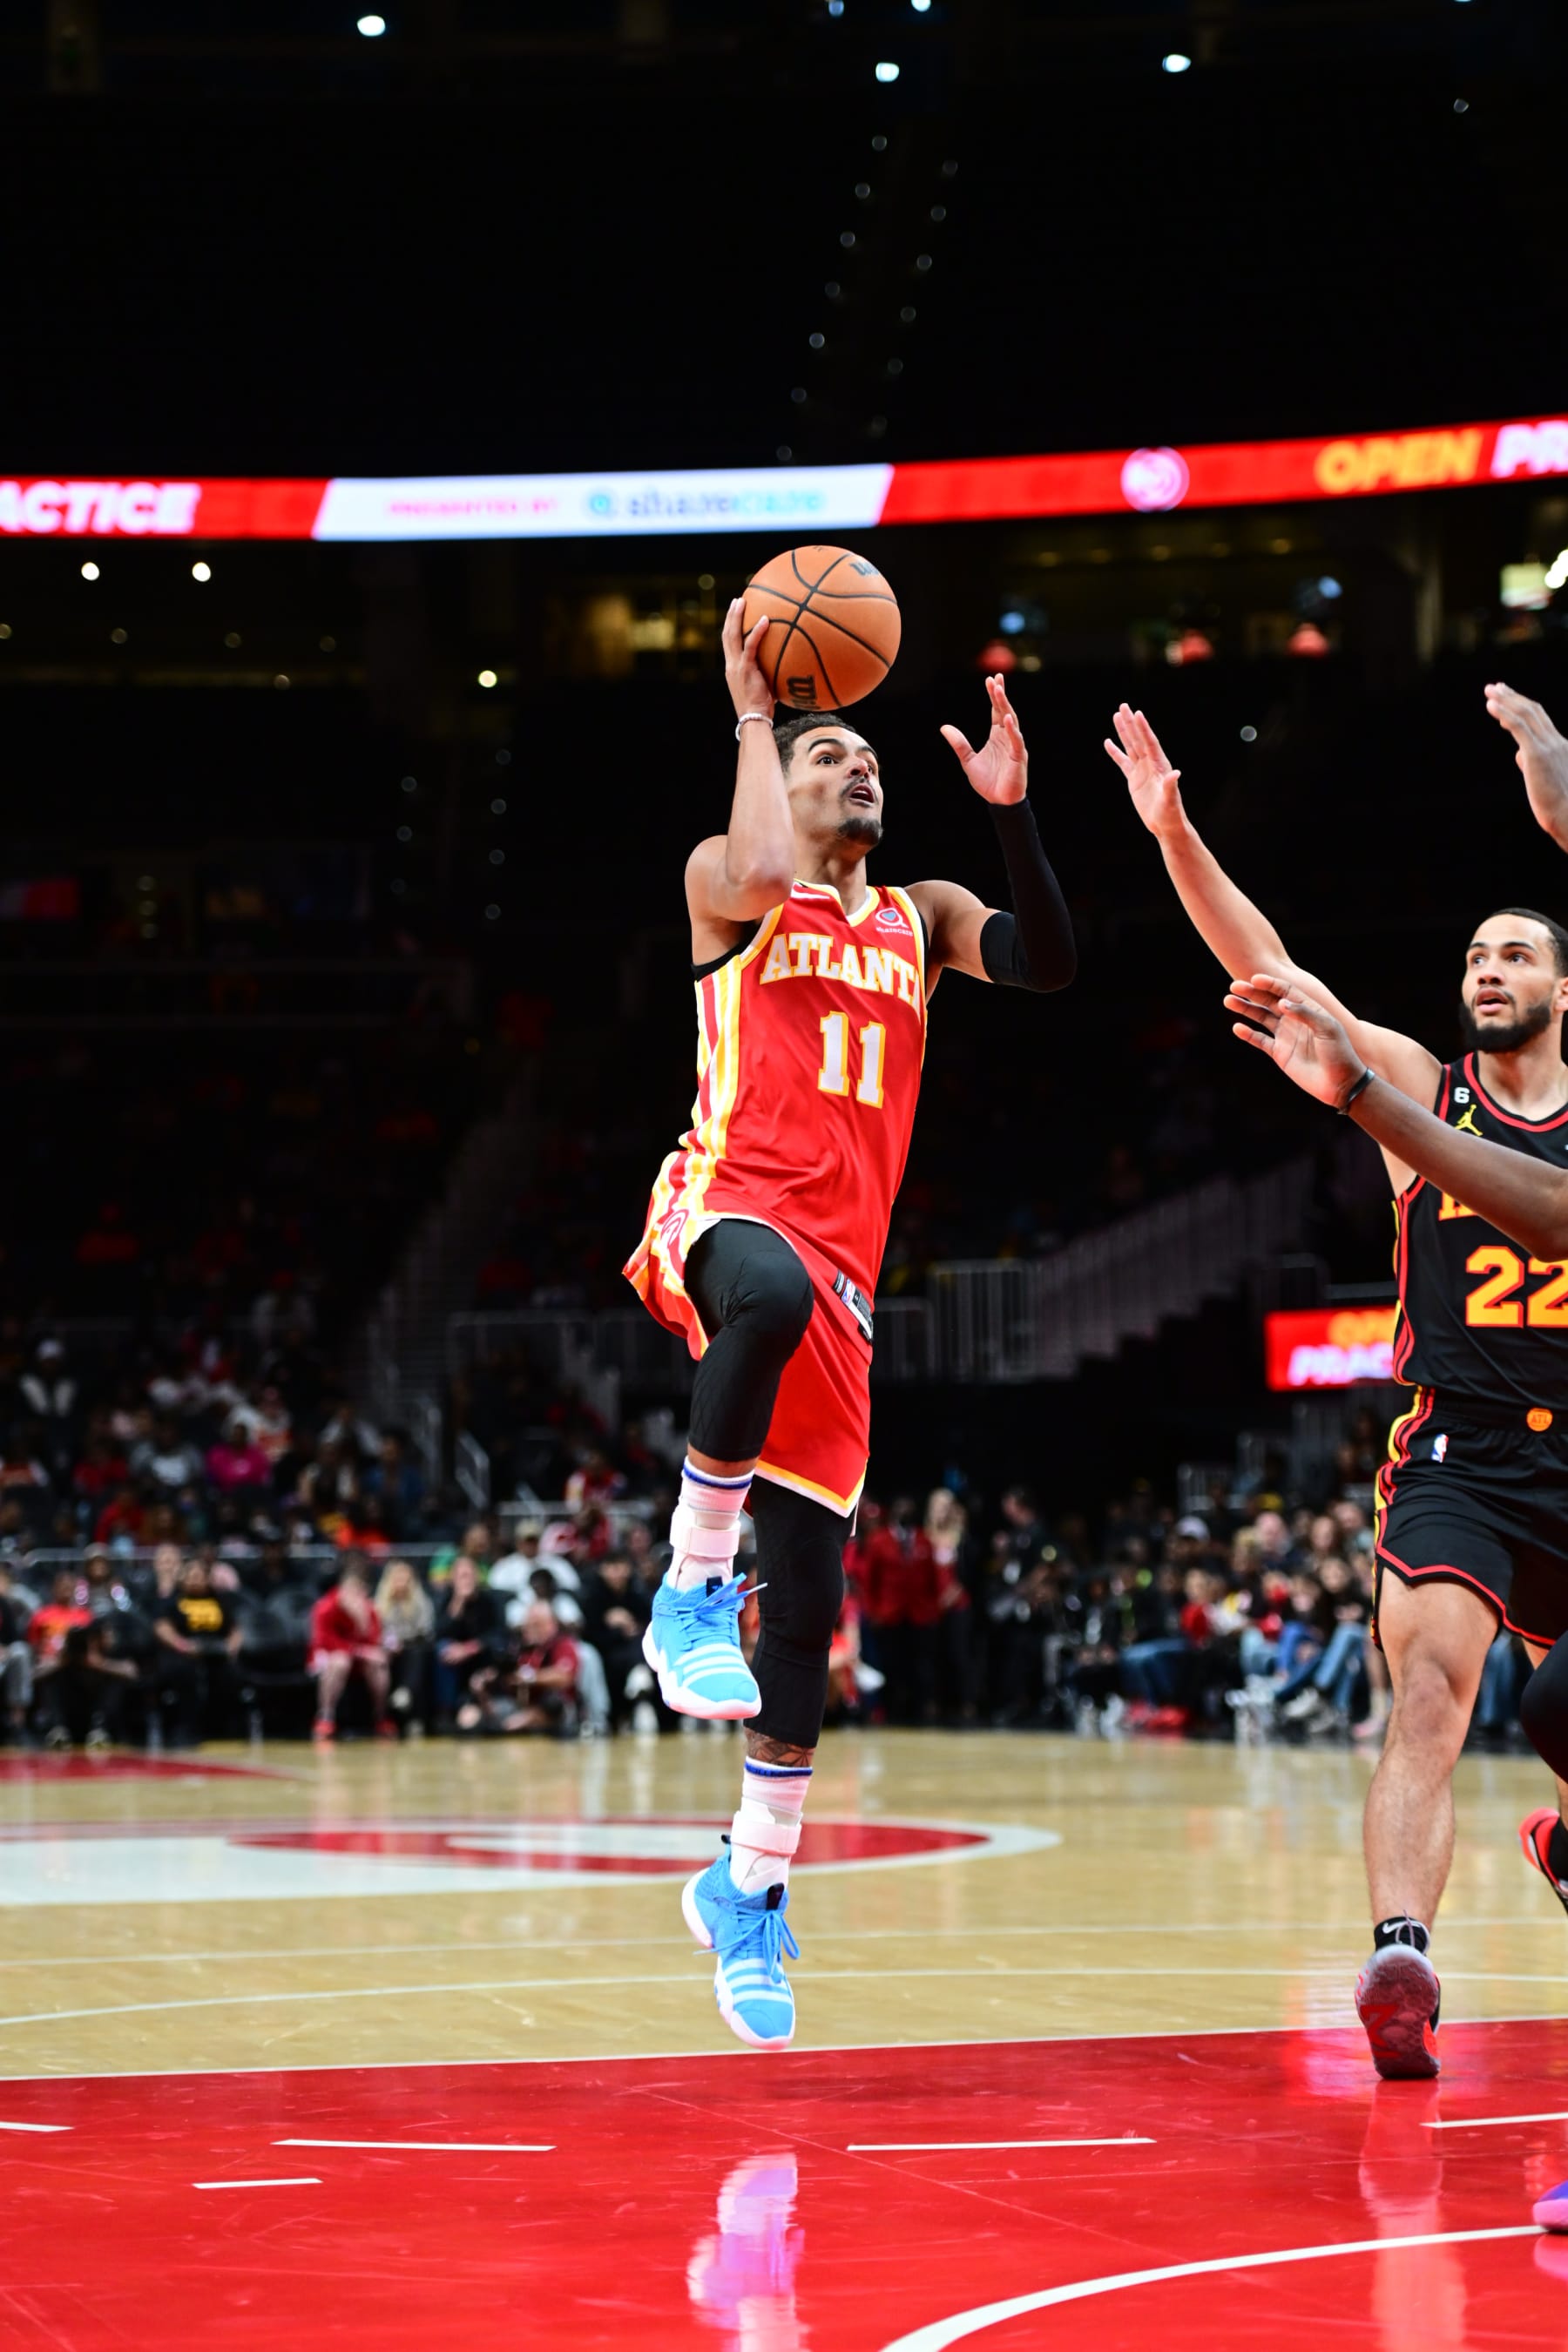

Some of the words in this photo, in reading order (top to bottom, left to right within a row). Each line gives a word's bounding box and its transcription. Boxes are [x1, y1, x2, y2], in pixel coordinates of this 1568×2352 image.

[1314, 427, 1483, 495] OPEN
[818, 1010, 886, 1109] 11
[1454, 1087, 1470, 1104] 6
[1465, 1246, 1568, 1328] 22
